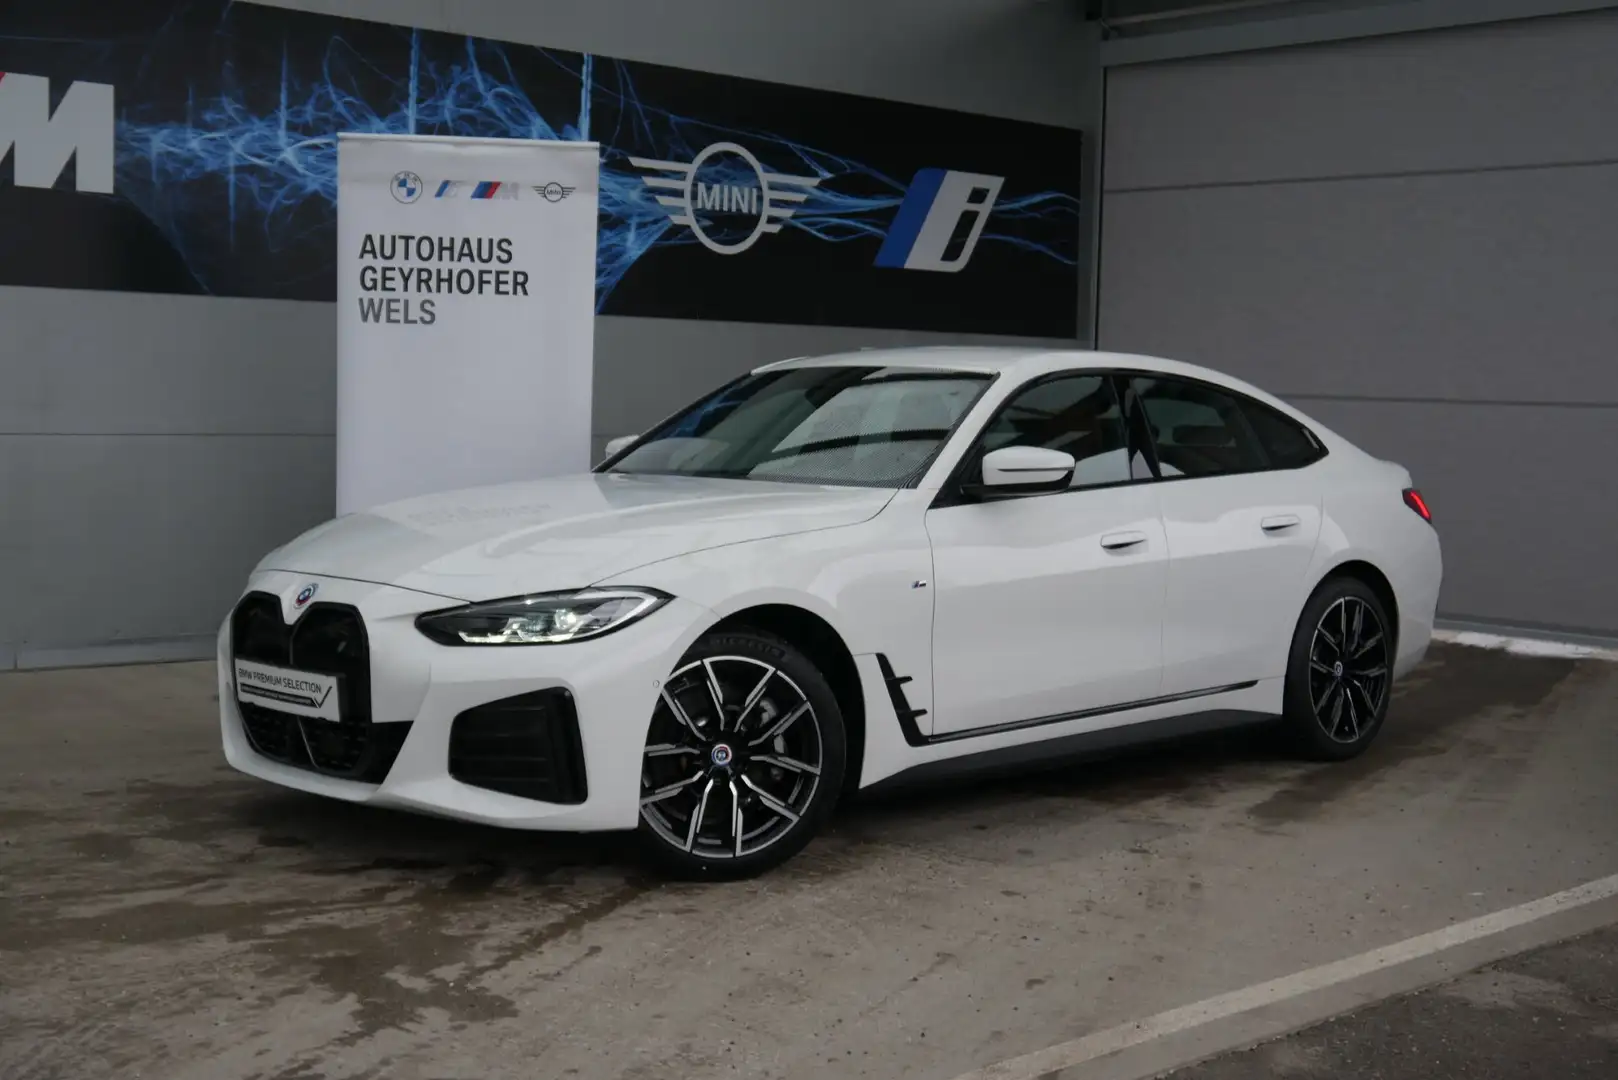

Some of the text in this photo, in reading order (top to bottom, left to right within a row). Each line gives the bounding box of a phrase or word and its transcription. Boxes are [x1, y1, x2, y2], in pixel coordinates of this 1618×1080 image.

[0, 71, 114, 194] M
[697, 182, 758, 215] MINI
[359, 234, 513, 264] AUTOHAUS
[359, 265, 529, 296] GEYRHOFER
[358, 298, 436, 325] WELS
[253, 672, 282, 686] PREMIUM
[283, 677, 322, 694] SELECTION
